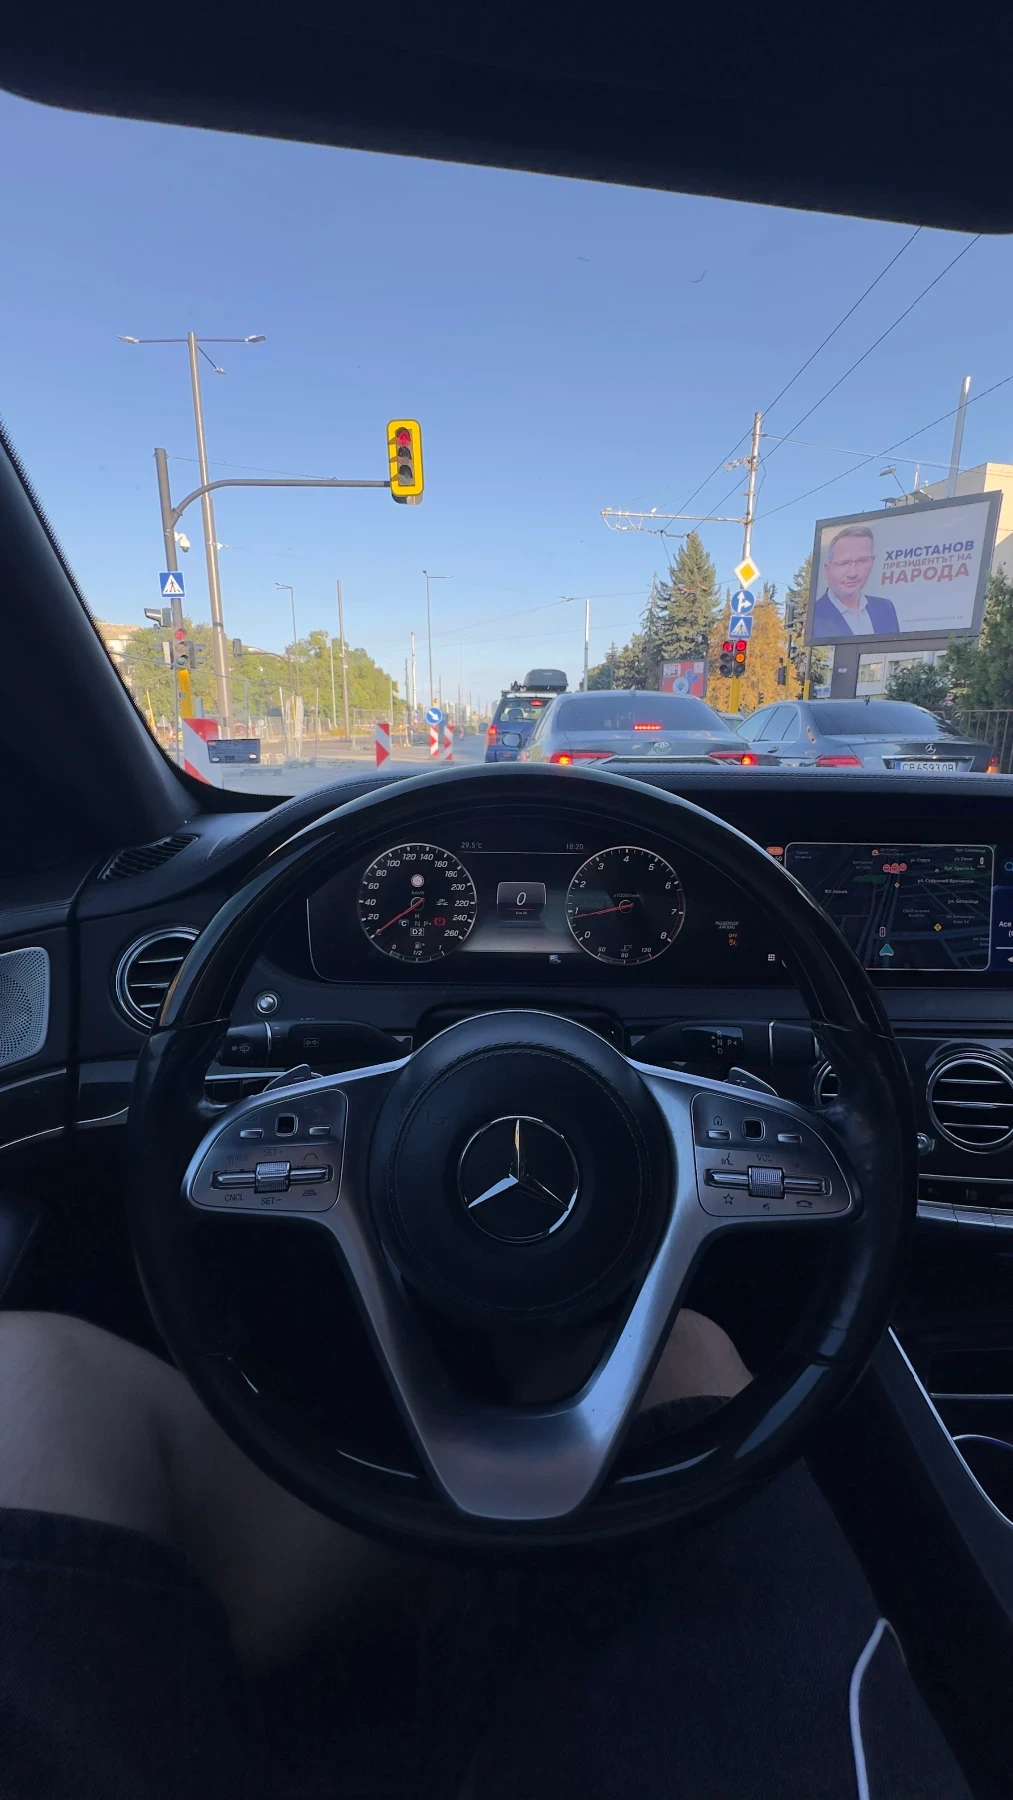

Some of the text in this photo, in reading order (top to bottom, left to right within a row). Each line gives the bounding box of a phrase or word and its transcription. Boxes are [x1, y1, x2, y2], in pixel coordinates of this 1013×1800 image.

[884, 540, 974, 562] ХРИСТАНОВ
[883, 553, 972, 570] ПРЕЗИДЕНТЪТ НА
[881, 562, 969, 586] НАРОДА
[516, 891, 526, 906] 0
[660, 932, 667, 940] 8
[263, 1149, 278, 1157] SET
[756, 1153, 772, 1162] VOL
[224, 1194, 245, 1202] CNCL
[261, 1197, 276, 1205] SET
